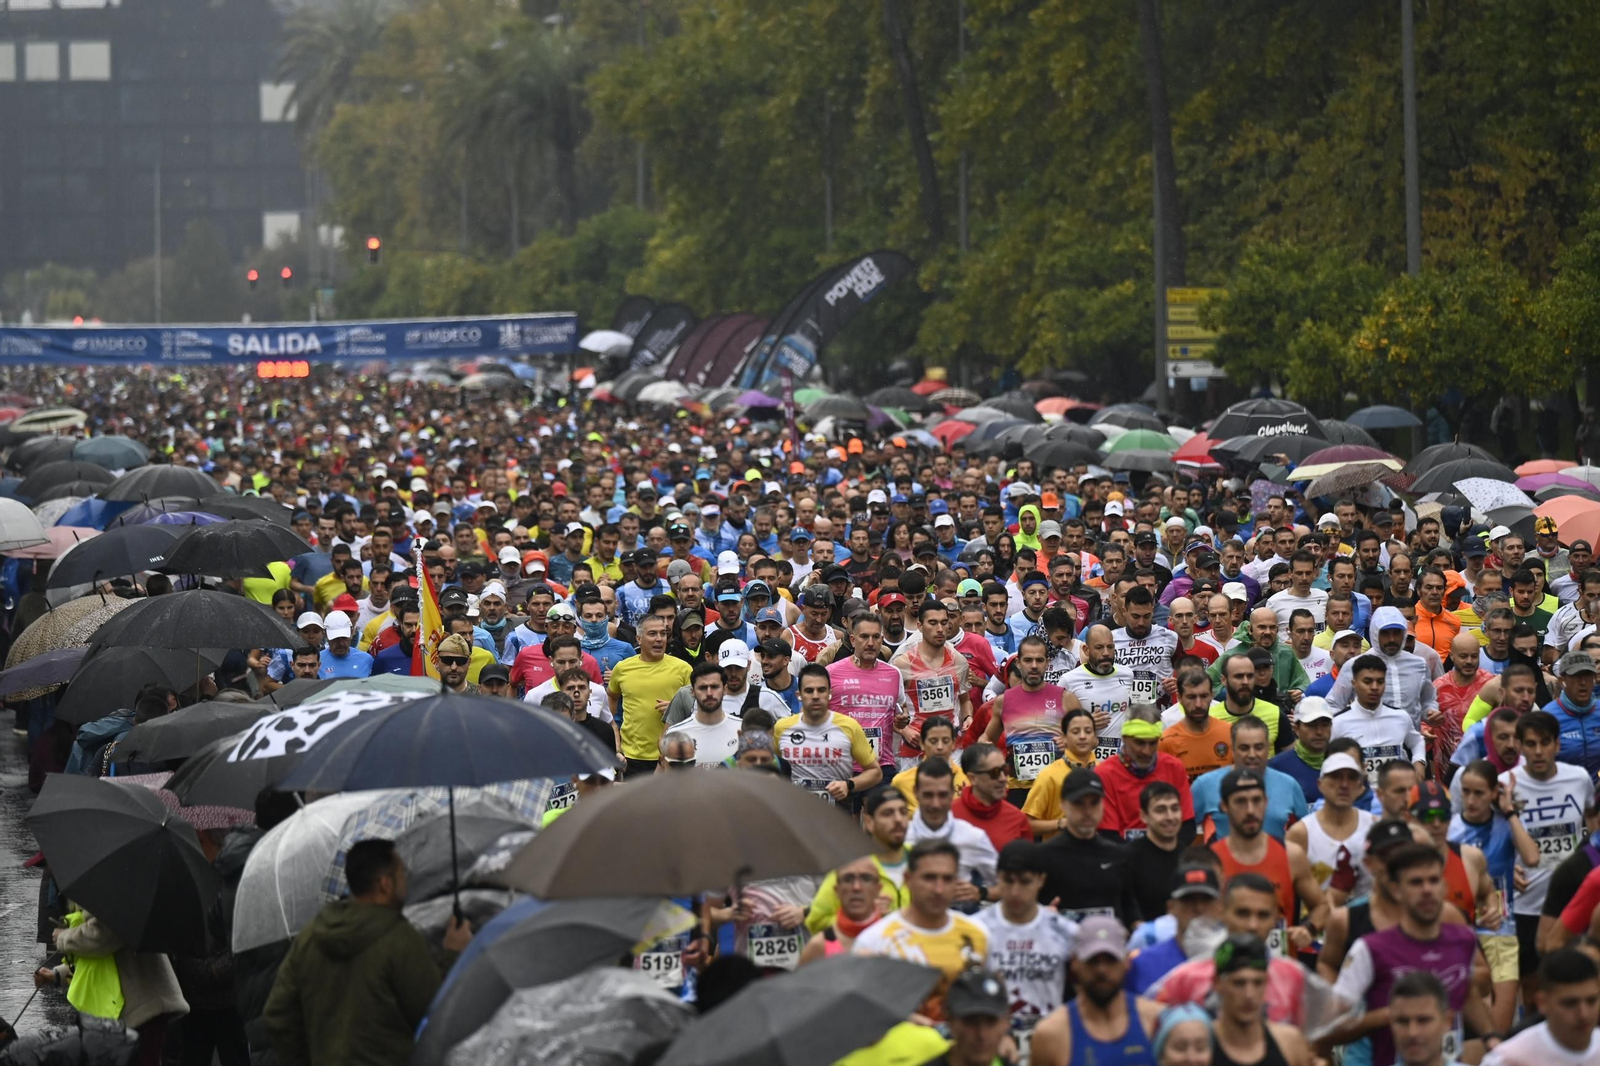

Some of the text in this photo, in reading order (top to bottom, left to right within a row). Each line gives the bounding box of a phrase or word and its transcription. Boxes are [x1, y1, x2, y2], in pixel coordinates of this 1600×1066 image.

[825, 257, 879, 307] POWER
[227, 332, 322, 356] SALIDA
[1128, 640, 1147, 648] CLUB
[1114, 656, 1162, 666] MONTORO
[922, 687, 950, 701] 3561
[783, 747, 843, 759] BERLIN
[1019, 753, 1050, 767] 2450
[755, 937, 797, 956] 2826
[642, 953, 681, 970] 5197
